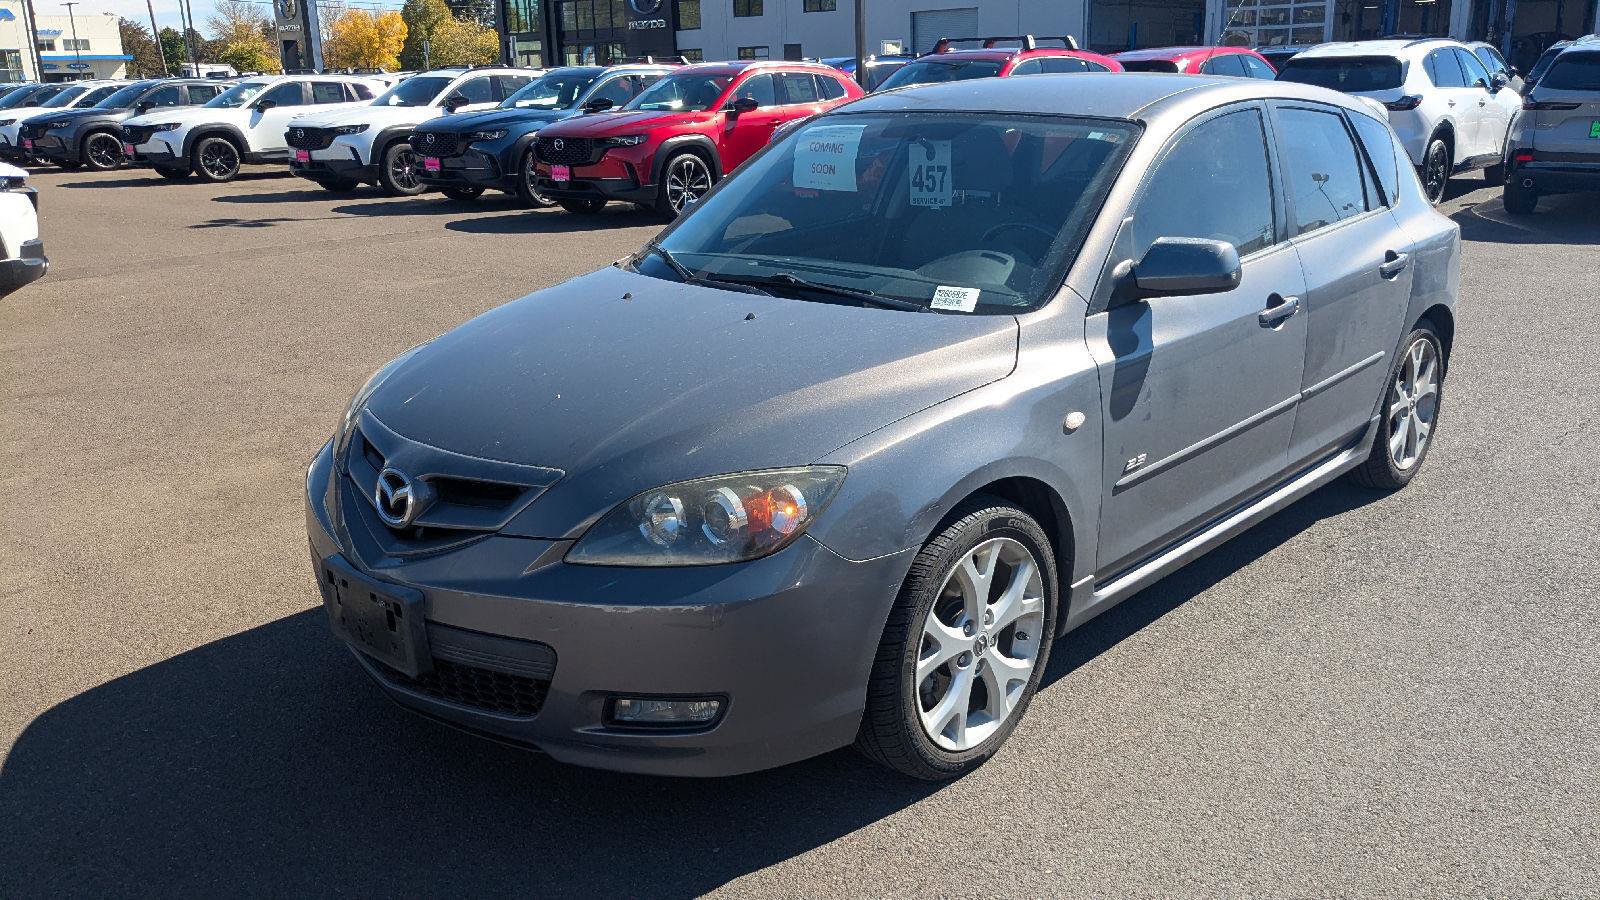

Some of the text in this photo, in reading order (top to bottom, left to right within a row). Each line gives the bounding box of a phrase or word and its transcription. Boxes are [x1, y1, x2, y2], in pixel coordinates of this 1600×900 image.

[809, 142, 844, 153] COMING
[811, 163, 836, 175] SOON
[912, 165, 947, 192] 457
